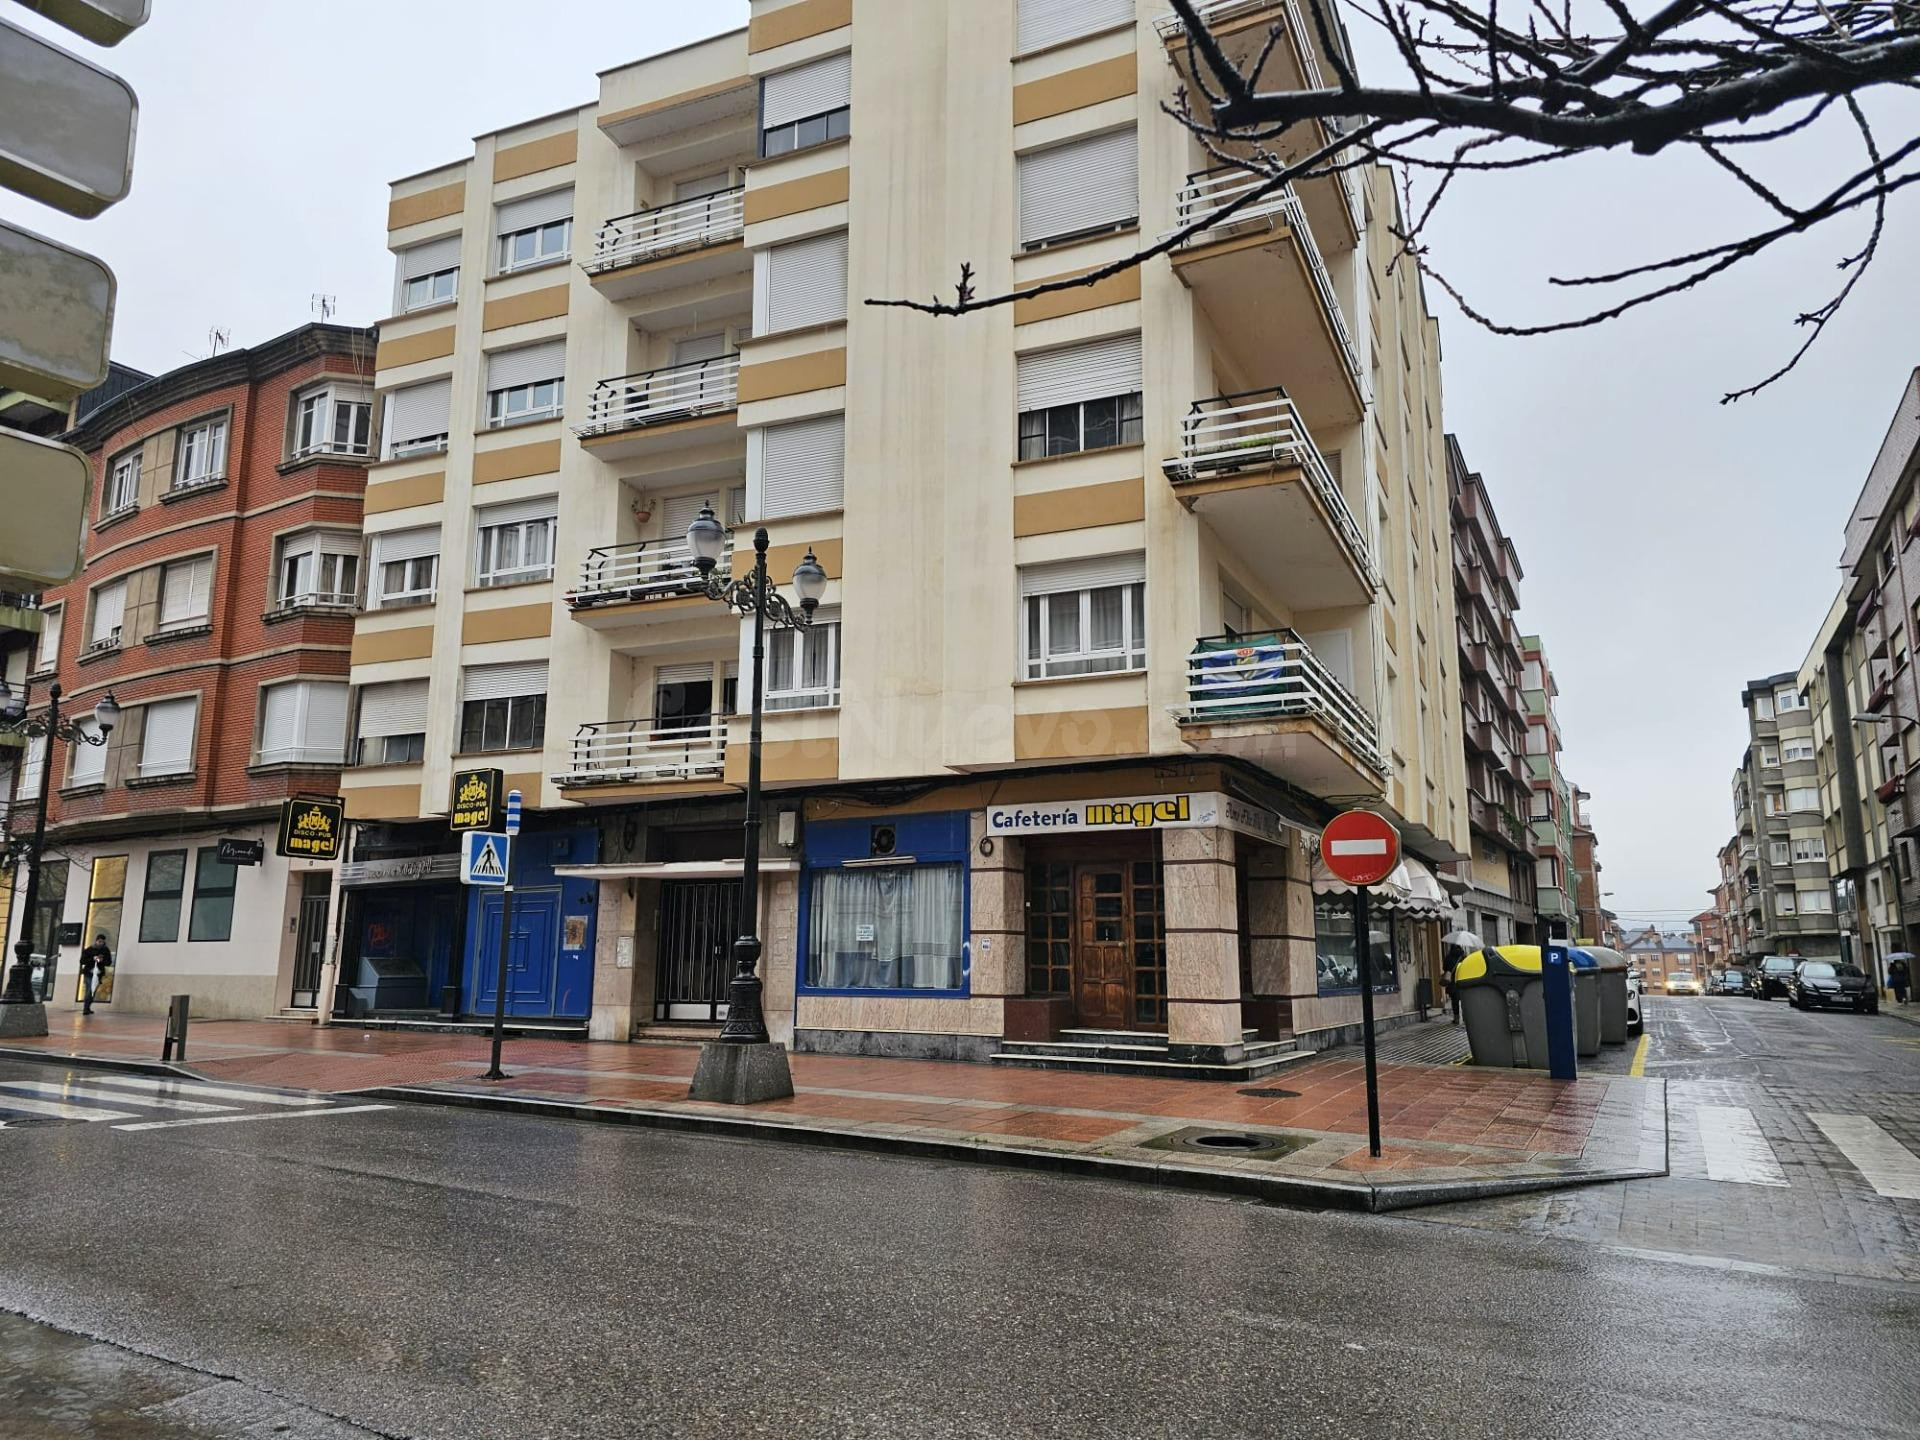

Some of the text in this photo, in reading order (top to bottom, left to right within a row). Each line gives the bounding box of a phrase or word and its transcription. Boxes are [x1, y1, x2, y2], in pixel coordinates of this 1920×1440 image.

[454, 806, 489, 826] magel
[992, 808, 1078, 828] Cafetería
[1085, 795, 1190, 828] magel
[290, 837, 335, 853] magel
[1550, 952, 1559, 963] P
